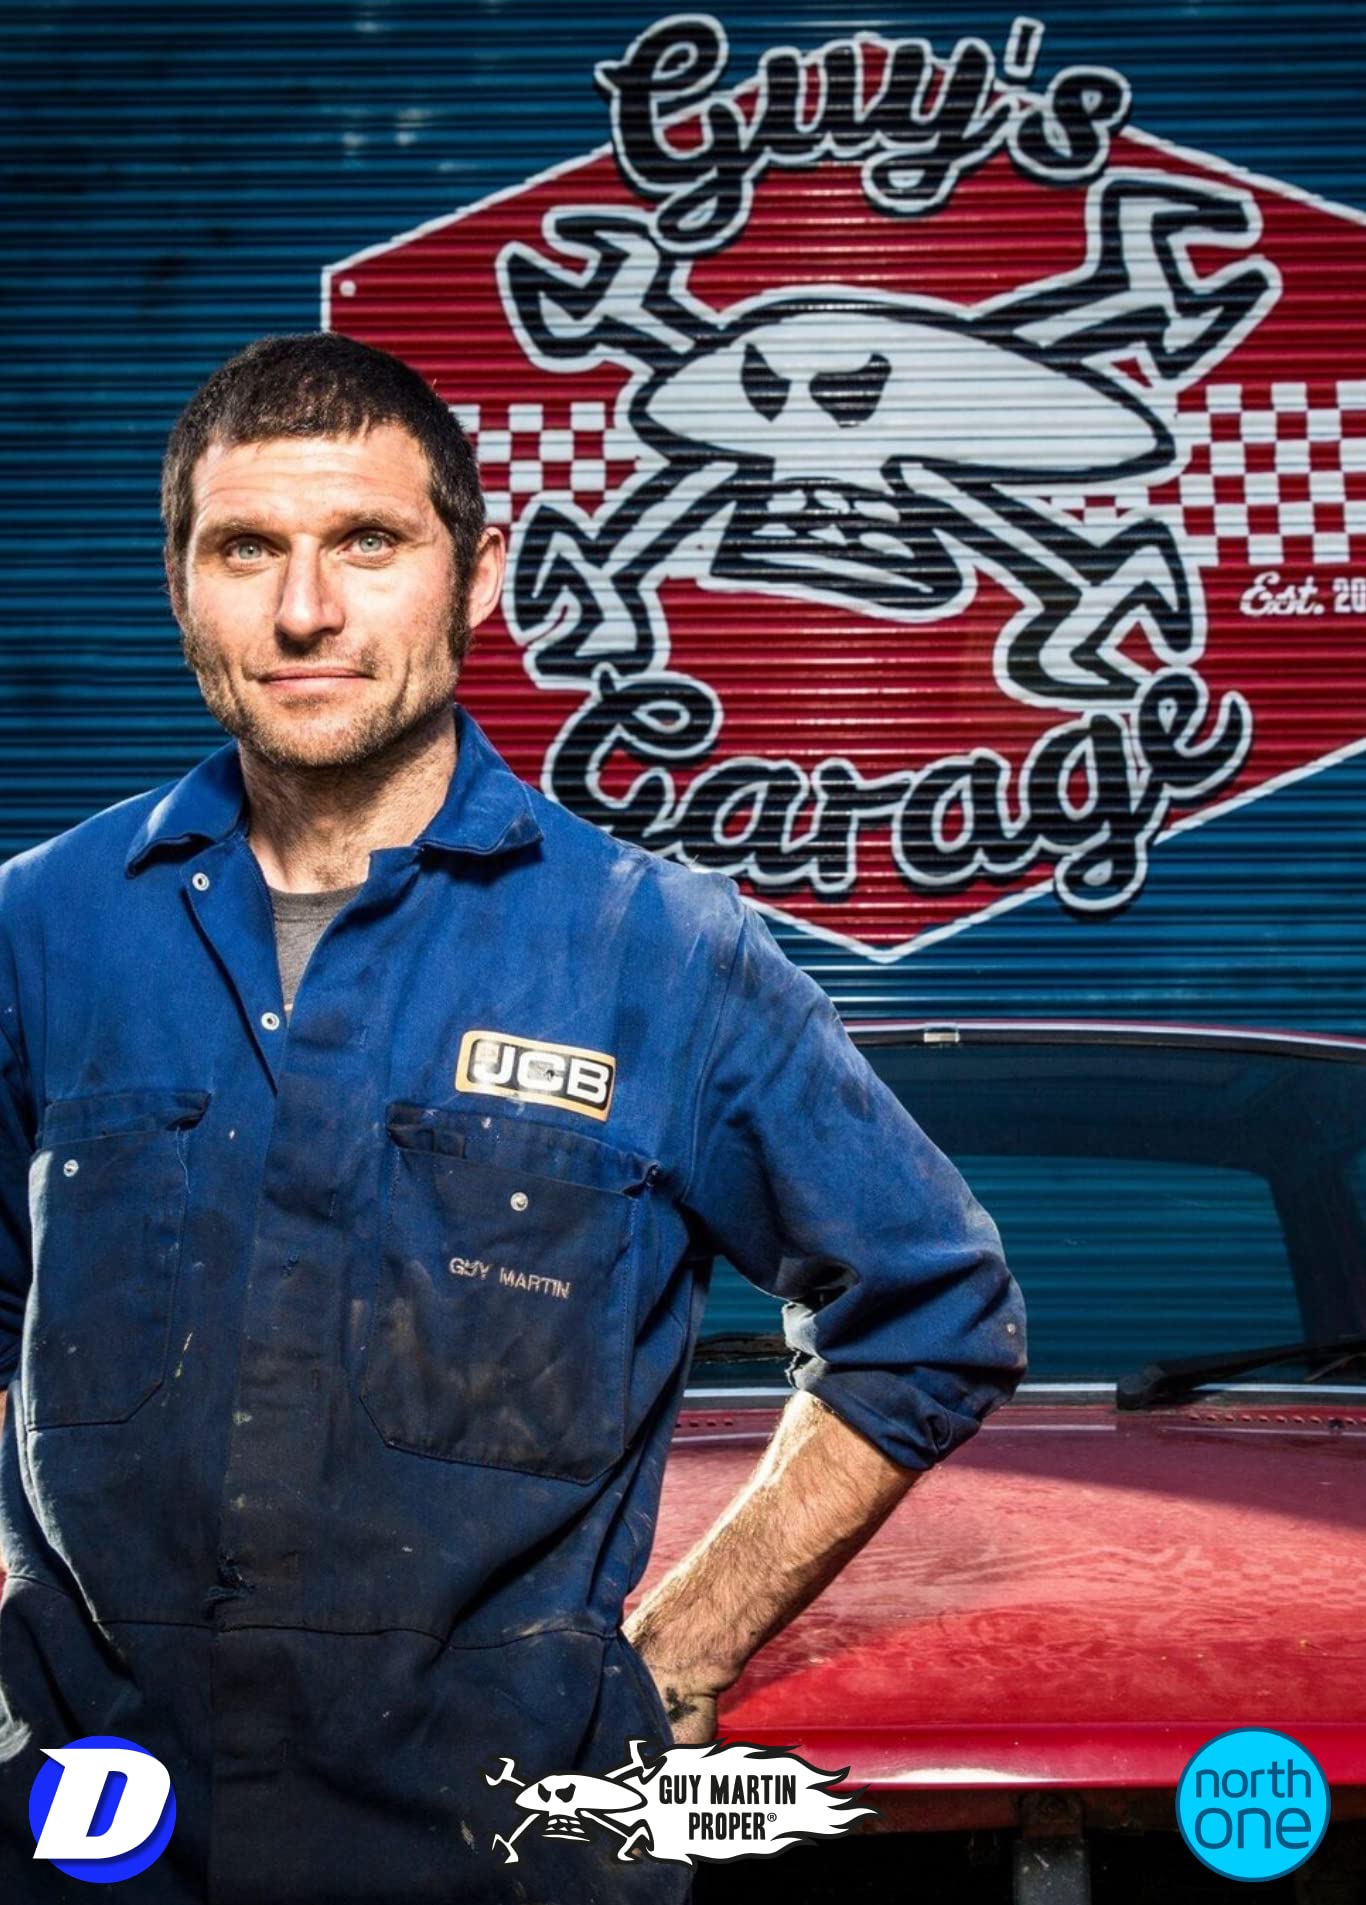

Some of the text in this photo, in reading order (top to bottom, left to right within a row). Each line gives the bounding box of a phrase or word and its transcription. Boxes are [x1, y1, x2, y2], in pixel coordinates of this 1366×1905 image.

[596, 15, 1132, 254] Guy's
[1240, 571, 1325, 616] Est.
[542, 666, 1251, 911] Garage
[472, 1040, 610, 1103] JCB
[499, 1267, 571, 1299] MARTIN
